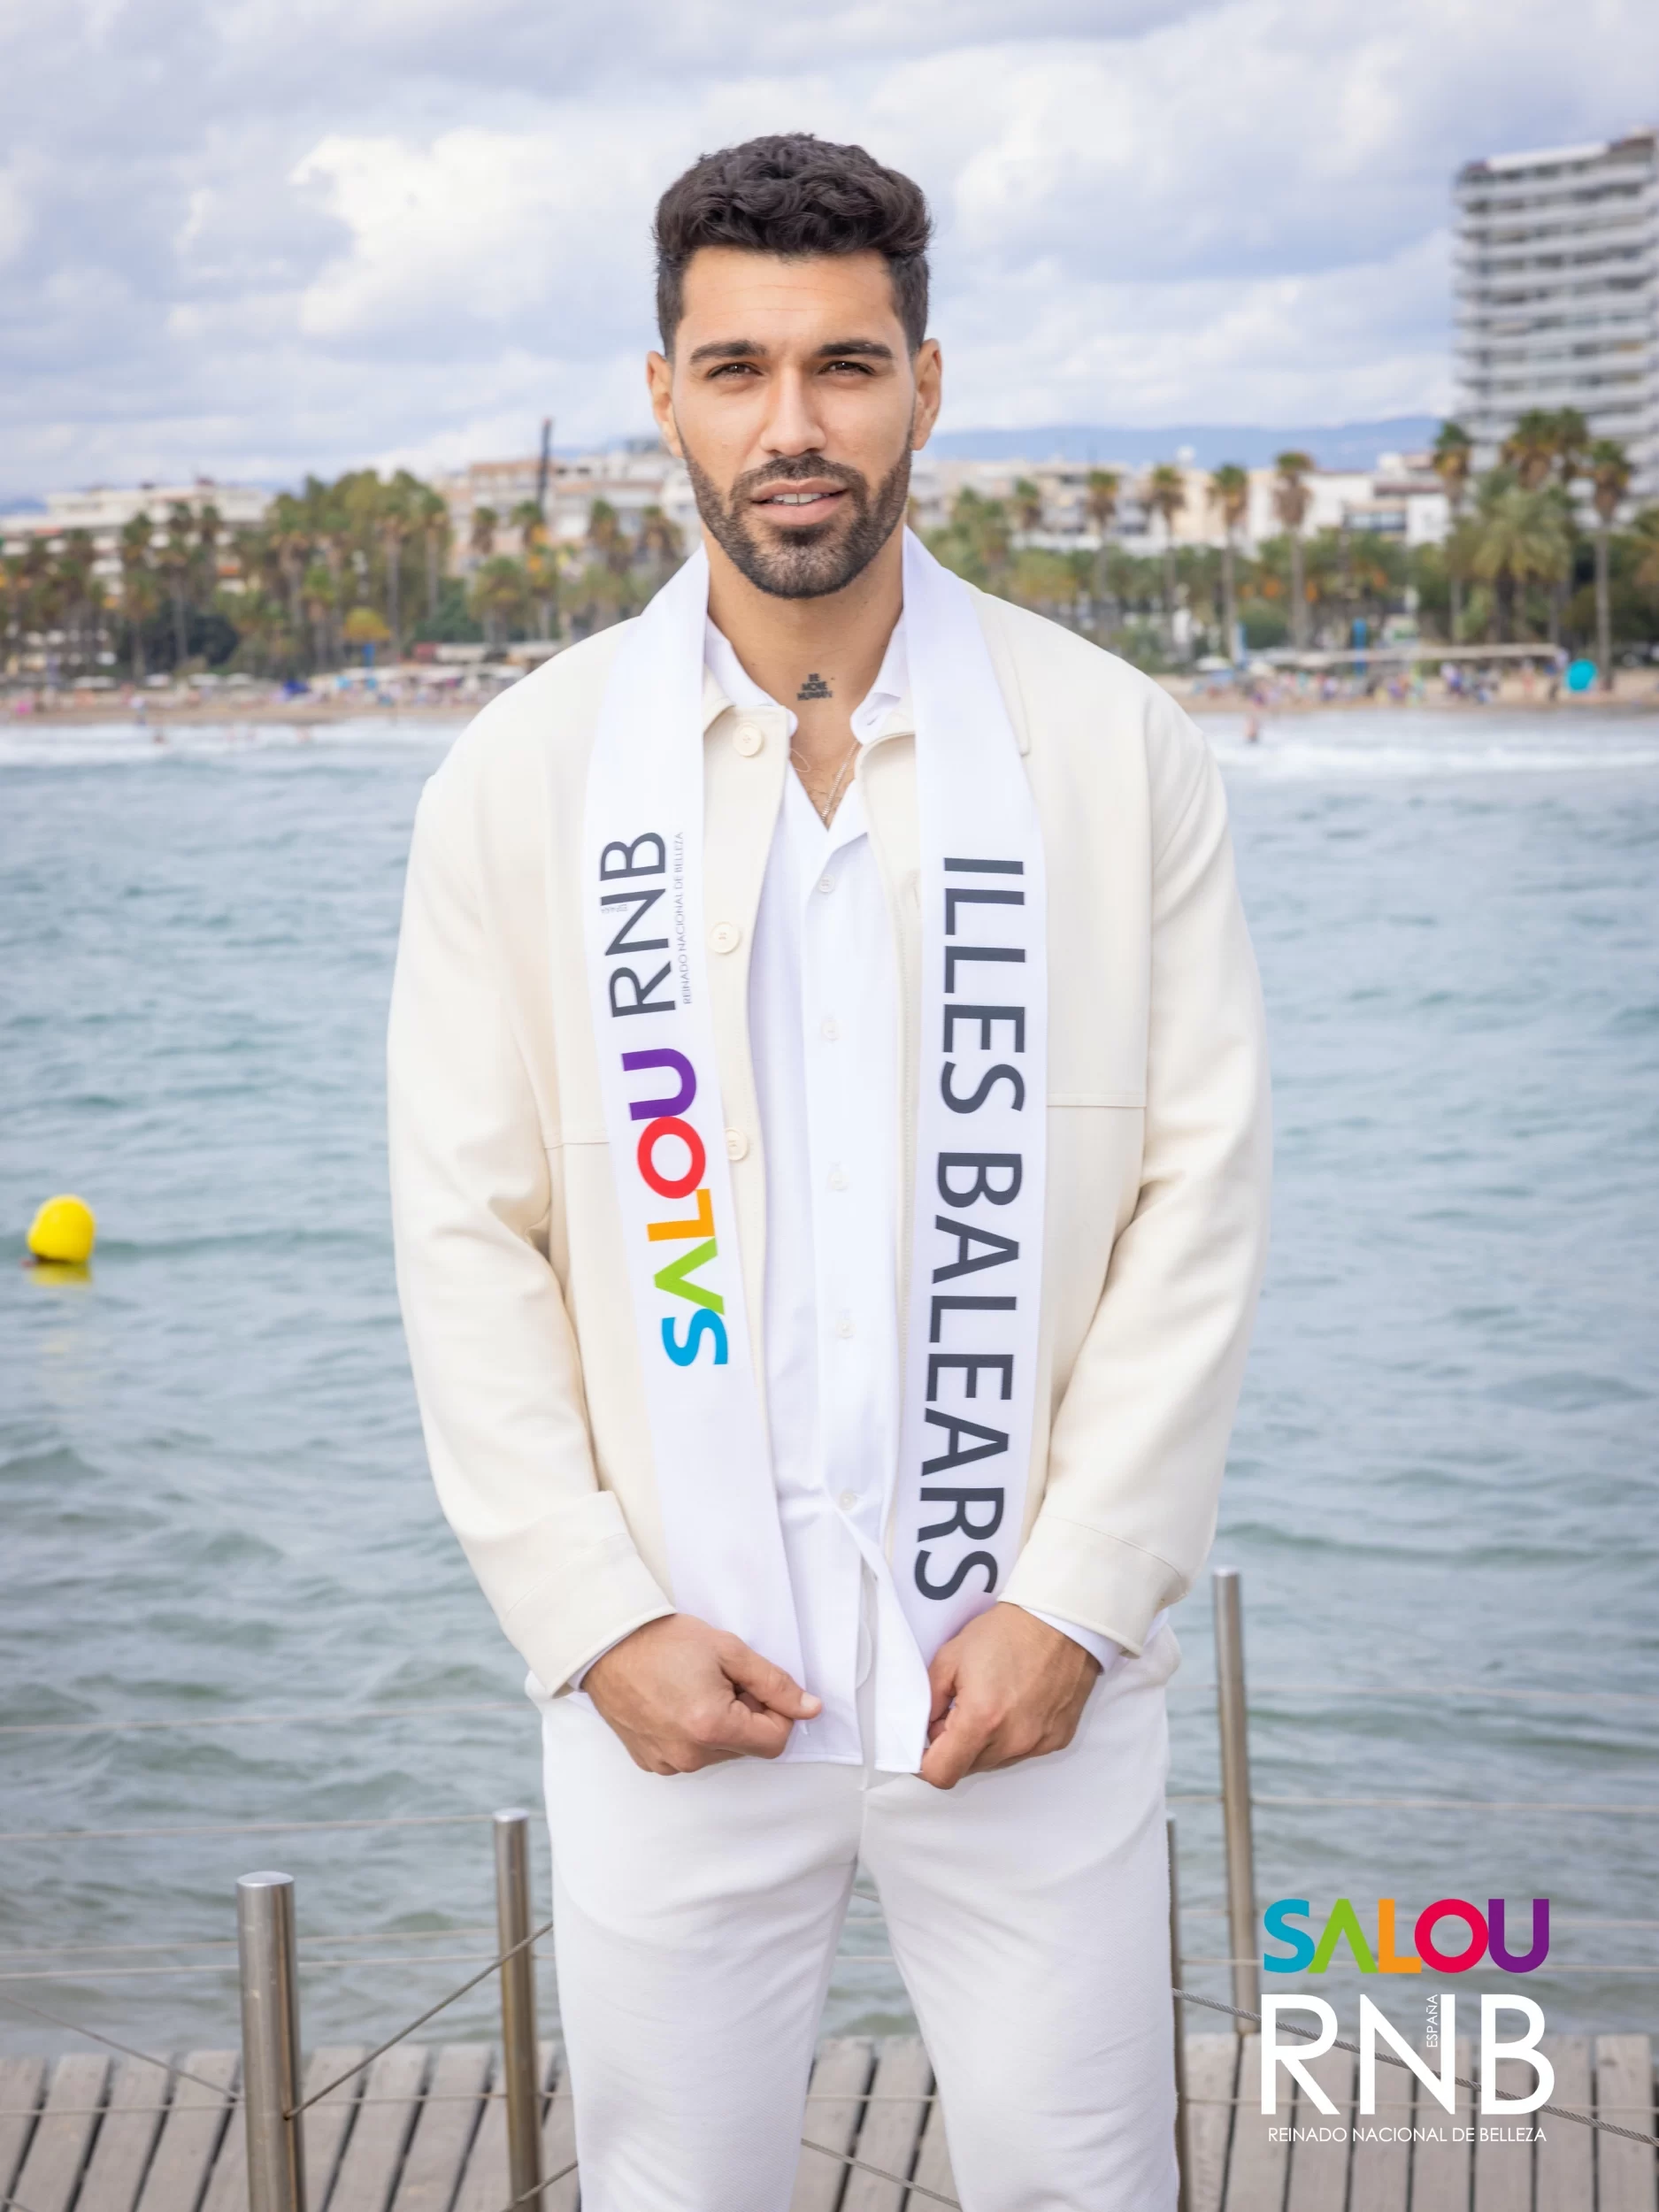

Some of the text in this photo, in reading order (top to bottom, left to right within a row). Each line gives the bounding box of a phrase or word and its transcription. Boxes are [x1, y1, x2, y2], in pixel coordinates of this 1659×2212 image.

[599, 832, 729, 1367] SALOU RNB
[672, 832, 693, 1004] REINADO NACIONAL DE BELLEZA
[914, 856, 1027, 1602] ILLES BALEARS
